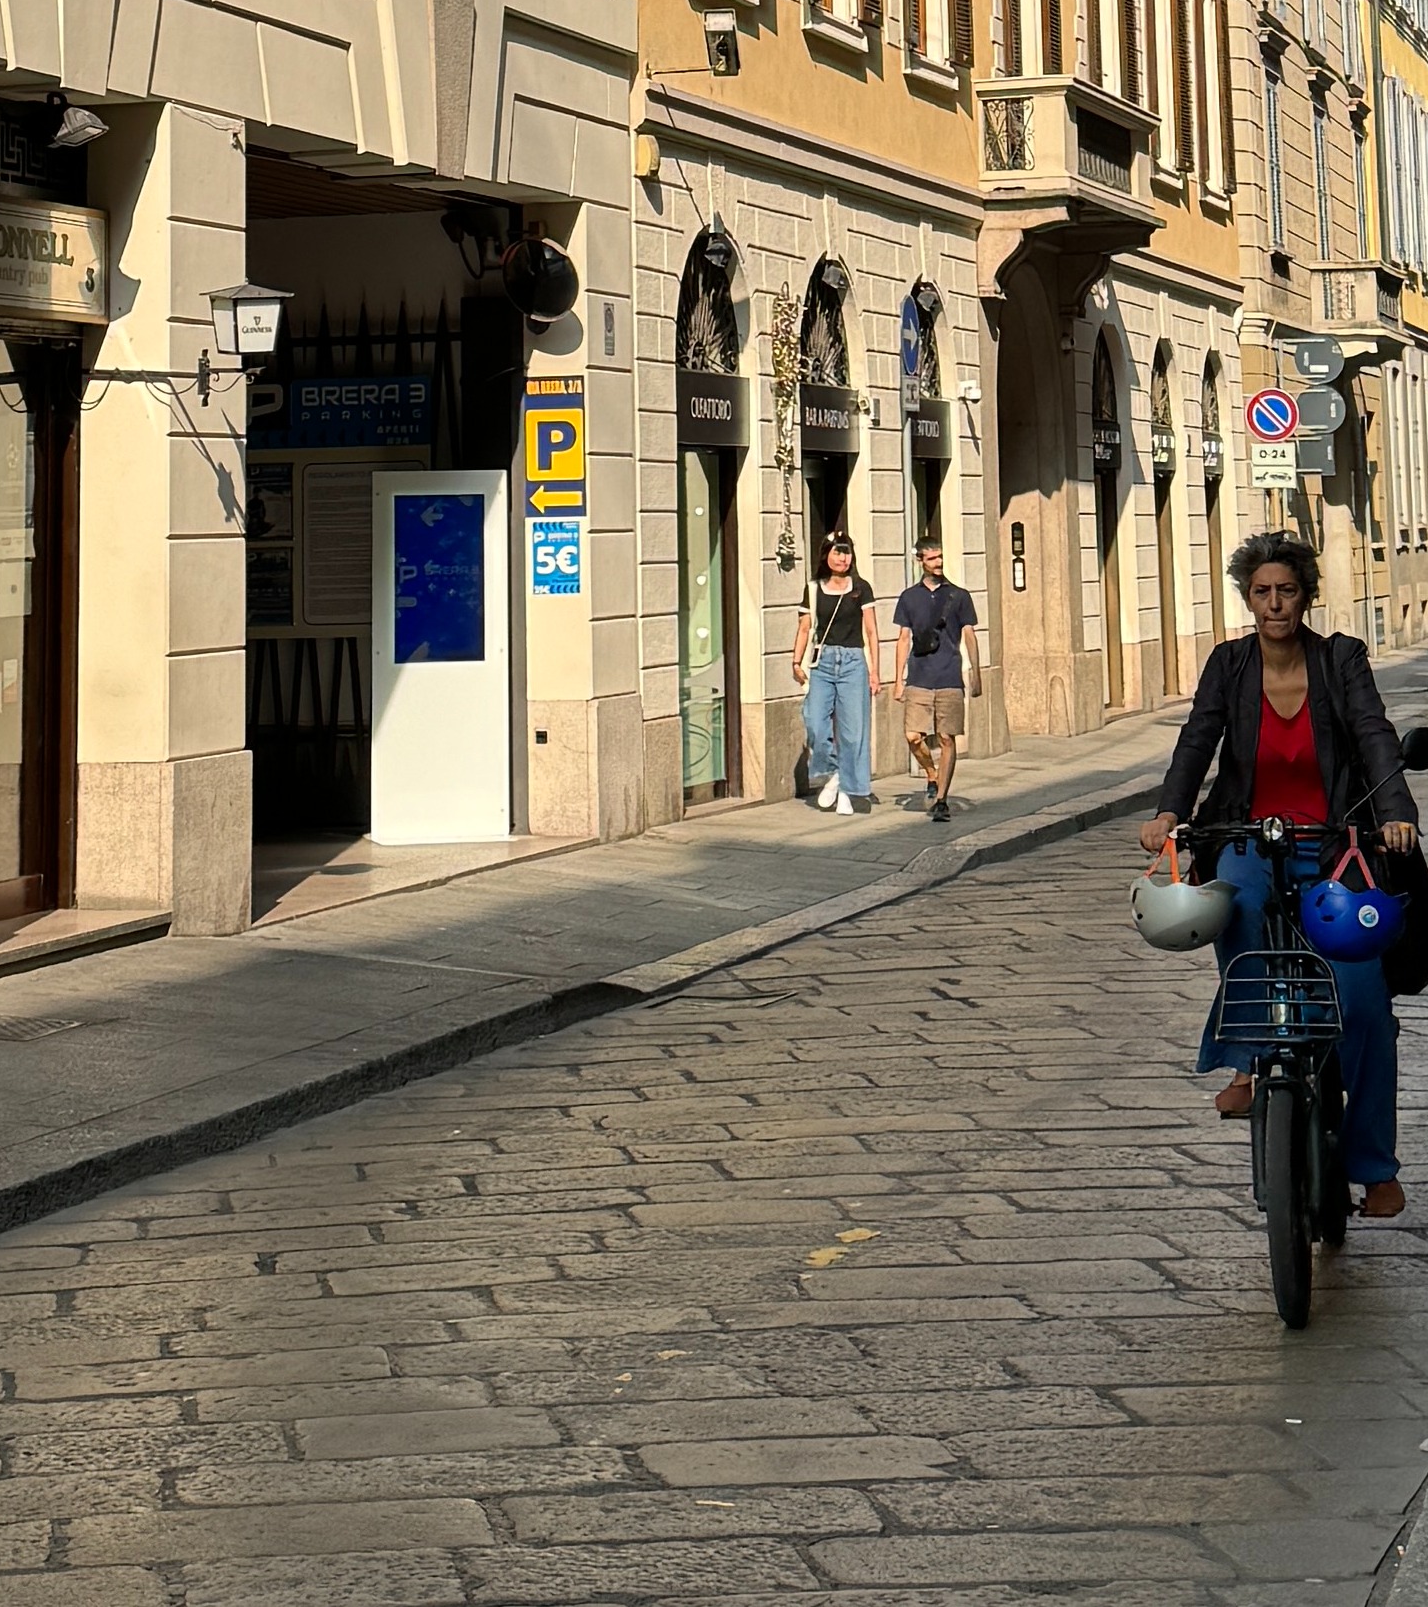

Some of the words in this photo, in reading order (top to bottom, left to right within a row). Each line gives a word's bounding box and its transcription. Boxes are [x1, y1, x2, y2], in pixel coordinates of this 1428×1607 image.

[27, 268, 49, 288] pub
[300, 383, 400, 407] BRERA
[408, 383, 426, 404] 3
[300, 408, 424, 421] PARKING
[537, 420, 577, 471] P
[1259, 449, 1286, 459] 0-24
[536, 545, 578, 574] 5€
